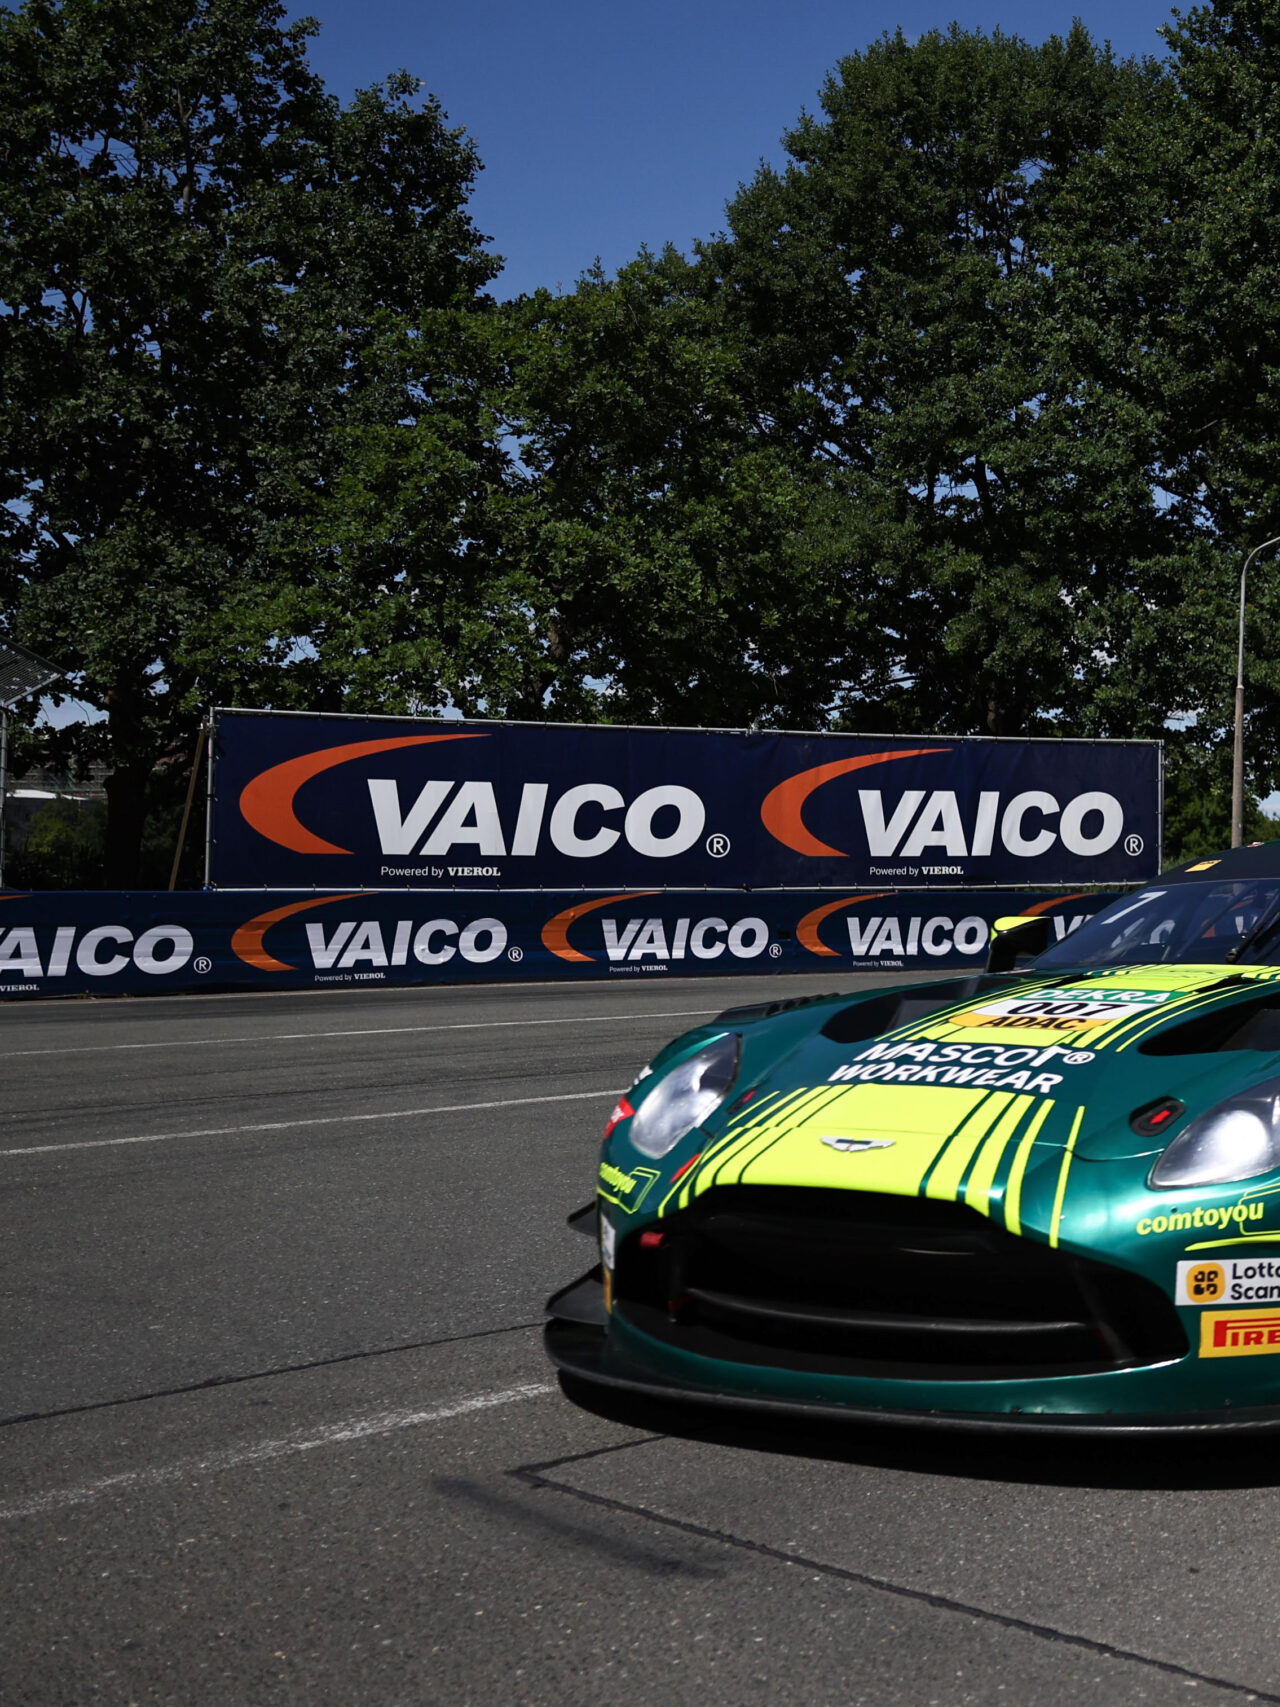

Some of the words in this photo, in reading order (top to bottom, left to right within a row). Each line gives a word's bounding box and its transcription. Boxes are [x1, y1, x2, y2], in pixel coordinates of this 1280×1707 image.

[380, 866, 428, 876] Powered
[431, 866, 444, 879] by
[447, 867, 501, 876] VIEROL
[869, 866, 907, 876] Powered
[908, 866, 919, 877] by
[921, 866, 964, 875] VIEROL
[609, 965, 633, 973] Powered
[634, 965, 641, 973] by
[641, 964, 668, 972] VIEROL
[314, 973, 343, 982] Powered
[344, 973, 352, 982] by
[354, 972, 386, 980] VIEROL
[1023, 988, 1172, 1002] DEKRA
[1007, 1002, 1129, 1018] 007
[977, 1016, 1087, 1031] ADAC
[827, 1062, 1064, 1093] WORKWEAR
[1136, 1202, 1264, 1236] comtoyou
